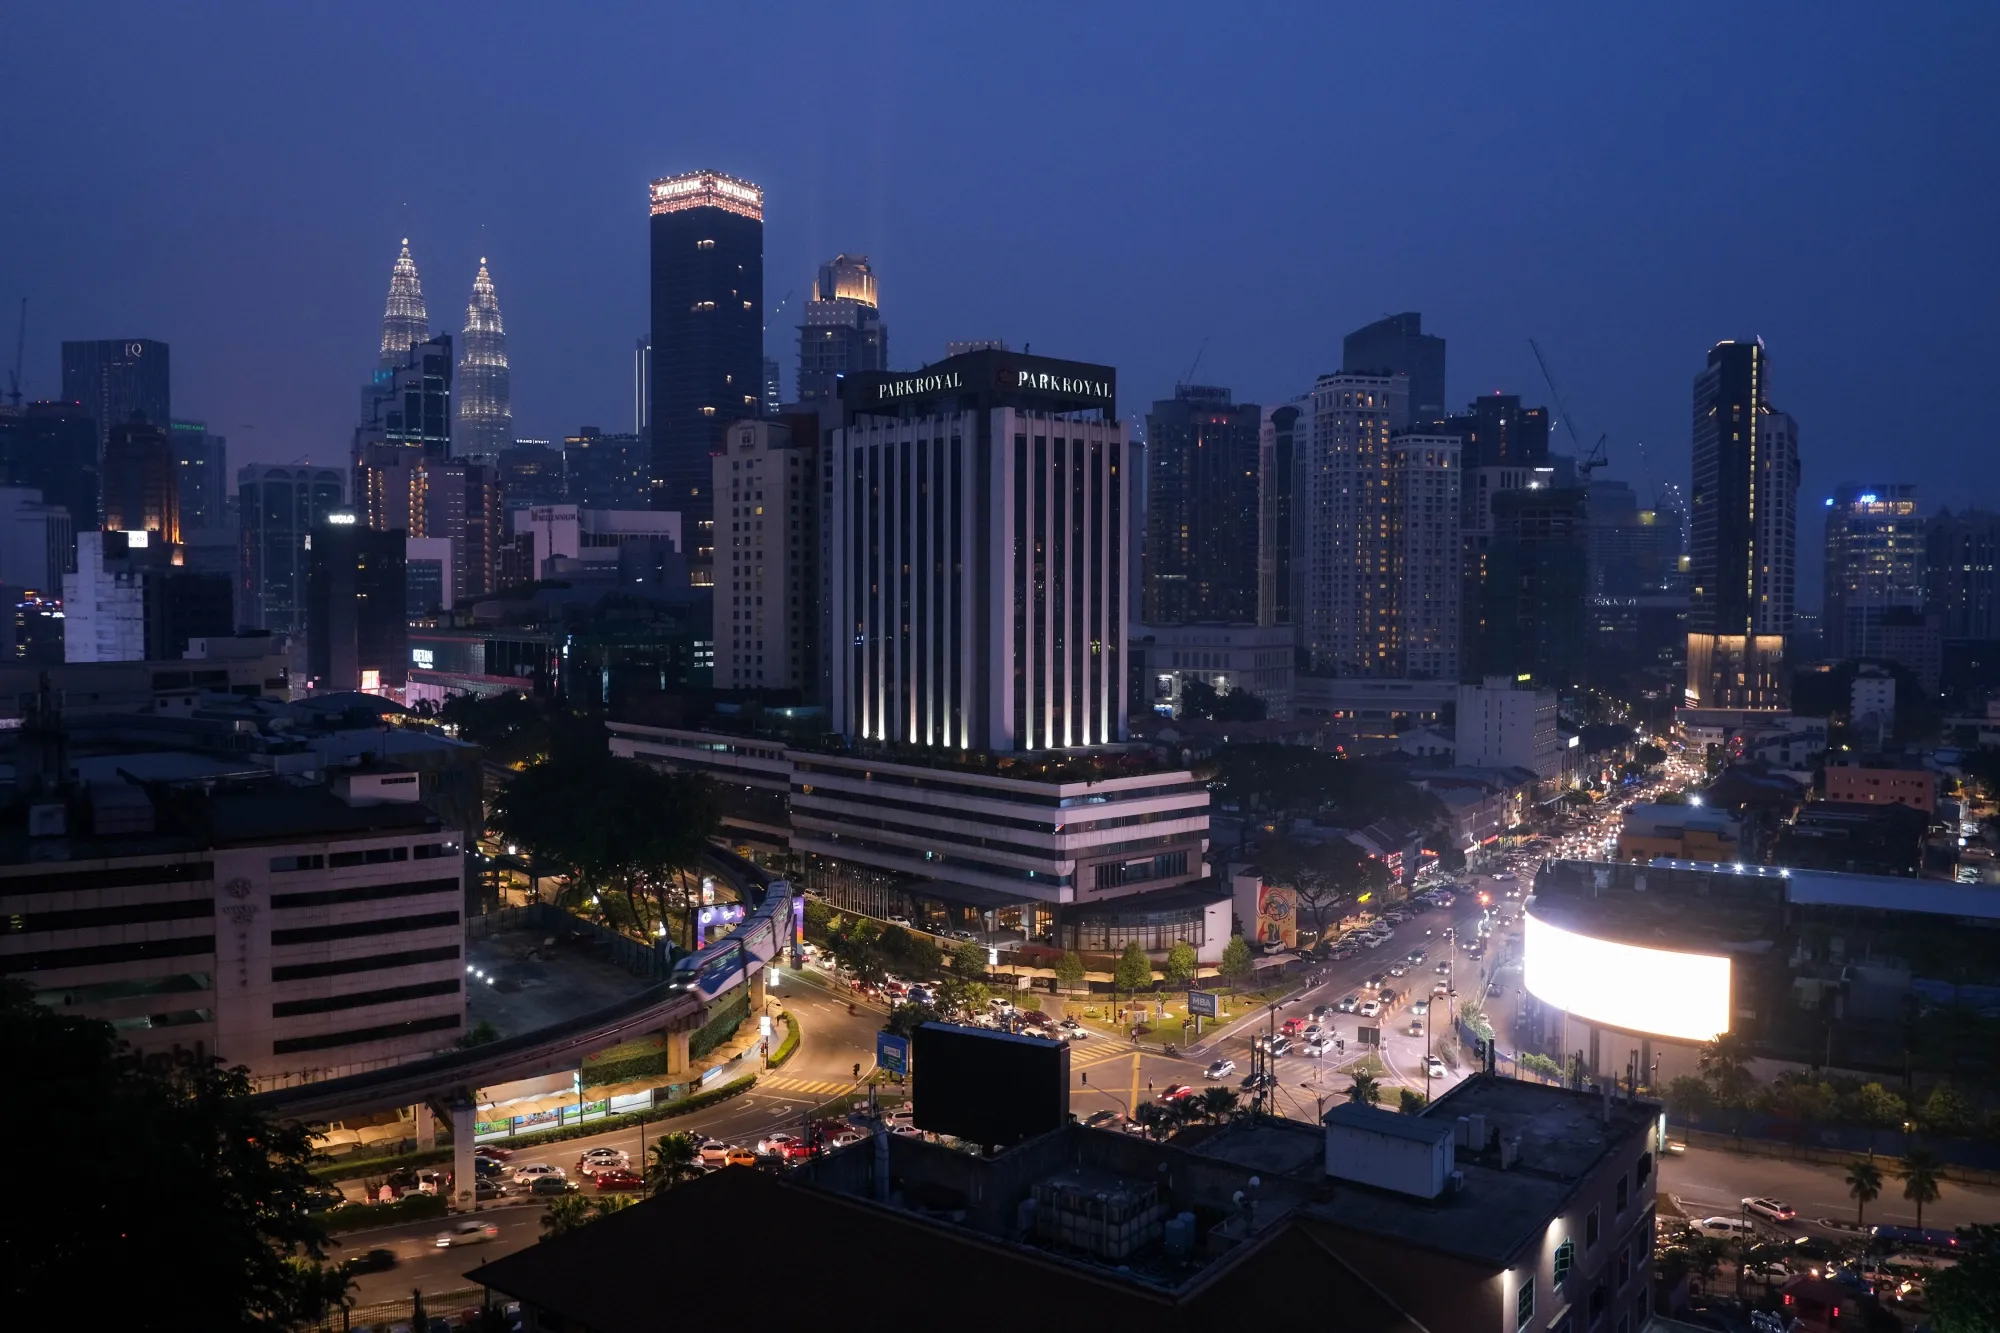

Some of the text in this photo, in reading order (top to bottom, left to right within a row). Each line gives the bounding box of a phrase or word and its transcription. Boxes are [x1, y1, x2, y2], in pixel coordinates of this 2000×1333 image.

[656, 180, 702, 197] PAVILION
[716, 180, 758, 202] PAVILION
[125, 342, 142, 357] EQ
[878, 372, 963, 400] PARKROYAL
[1017, 371, 1112, 399] PARKROYAL
[328, 514, 356, 524] WOLO
[538, 513, 576, 522] MILLENNIUM
[1192, 996, 1211, 1008] MBA
